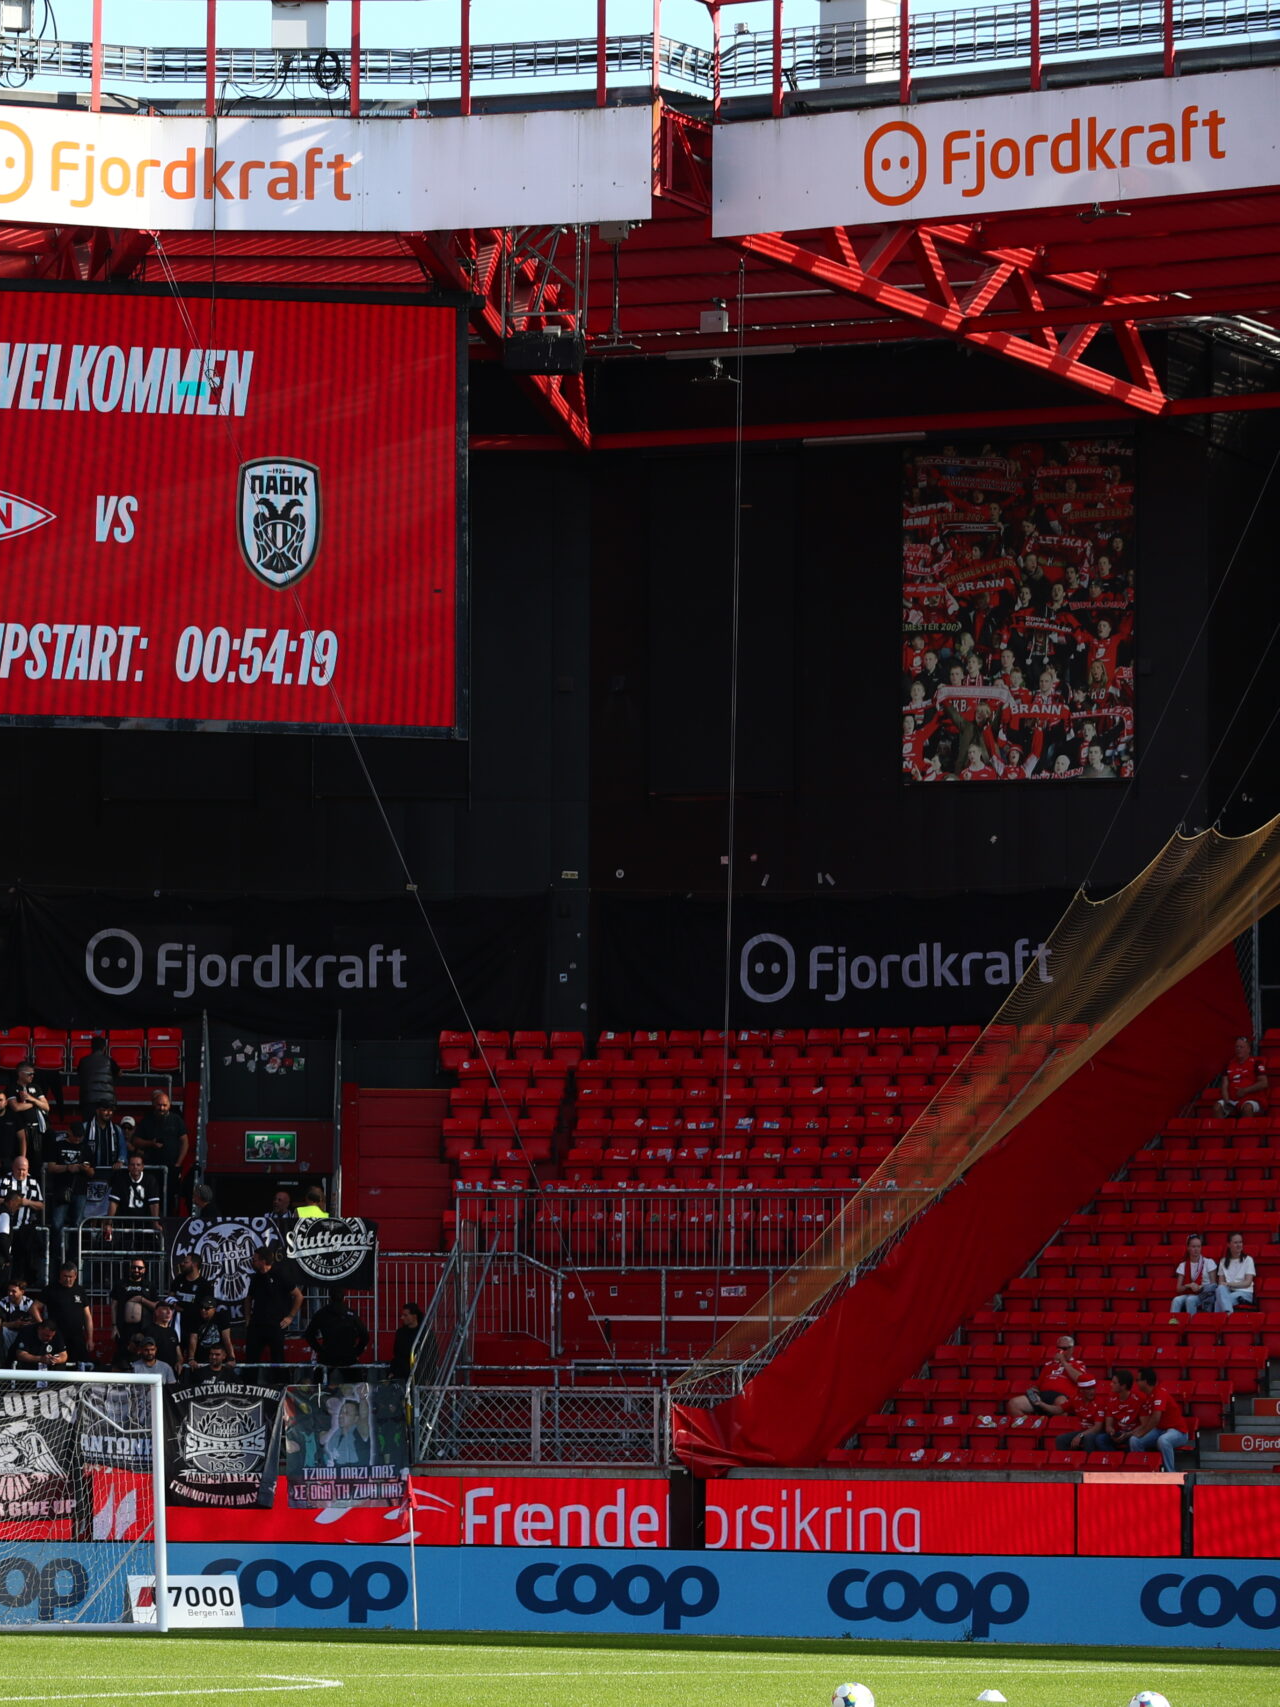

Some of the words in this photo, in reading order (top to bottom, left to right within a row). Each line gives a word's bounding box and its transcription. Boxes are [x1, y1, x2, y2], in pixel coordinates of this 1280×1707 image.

[50, 140, 352, 208] Fjordkraft
[942, 105, 1226, 198] Fjordkraft
[96, 495, 138, 543] VS
[956, 579, 1005, 593] BRANN
[175, 625, 339, 686] 00:54:19
[1010, 704, 1062, 714] BRANN
[156, 943, 408, 998] Fjordkraft
[809, 938, 1054, 1001] Fjordkraft
[286, 1230, 375, 1255] Stuttgart
[303, 1257, 331, 1275] ALWAYS
[332, 1266, 343, 1275] ON
[344, 1251, 361, 1269] TOUR
[332, 1252, 348, 1266] 1997
[185, 1432, 266, 1453] SERRES
[7, 1500, 50, 1516] GIVE
[52, 1499, 76, 1514] UP
[464, 1486, 660, 1547] Frende
[666, 1488, 920, 1553] orsikring
[188, 1609, 218, 1618] Bergen
[220, 1609, 236, 1617] Taxi
[516, 1562, 720, 1630] coop
[827, 1568, 1030, 1638] coop
